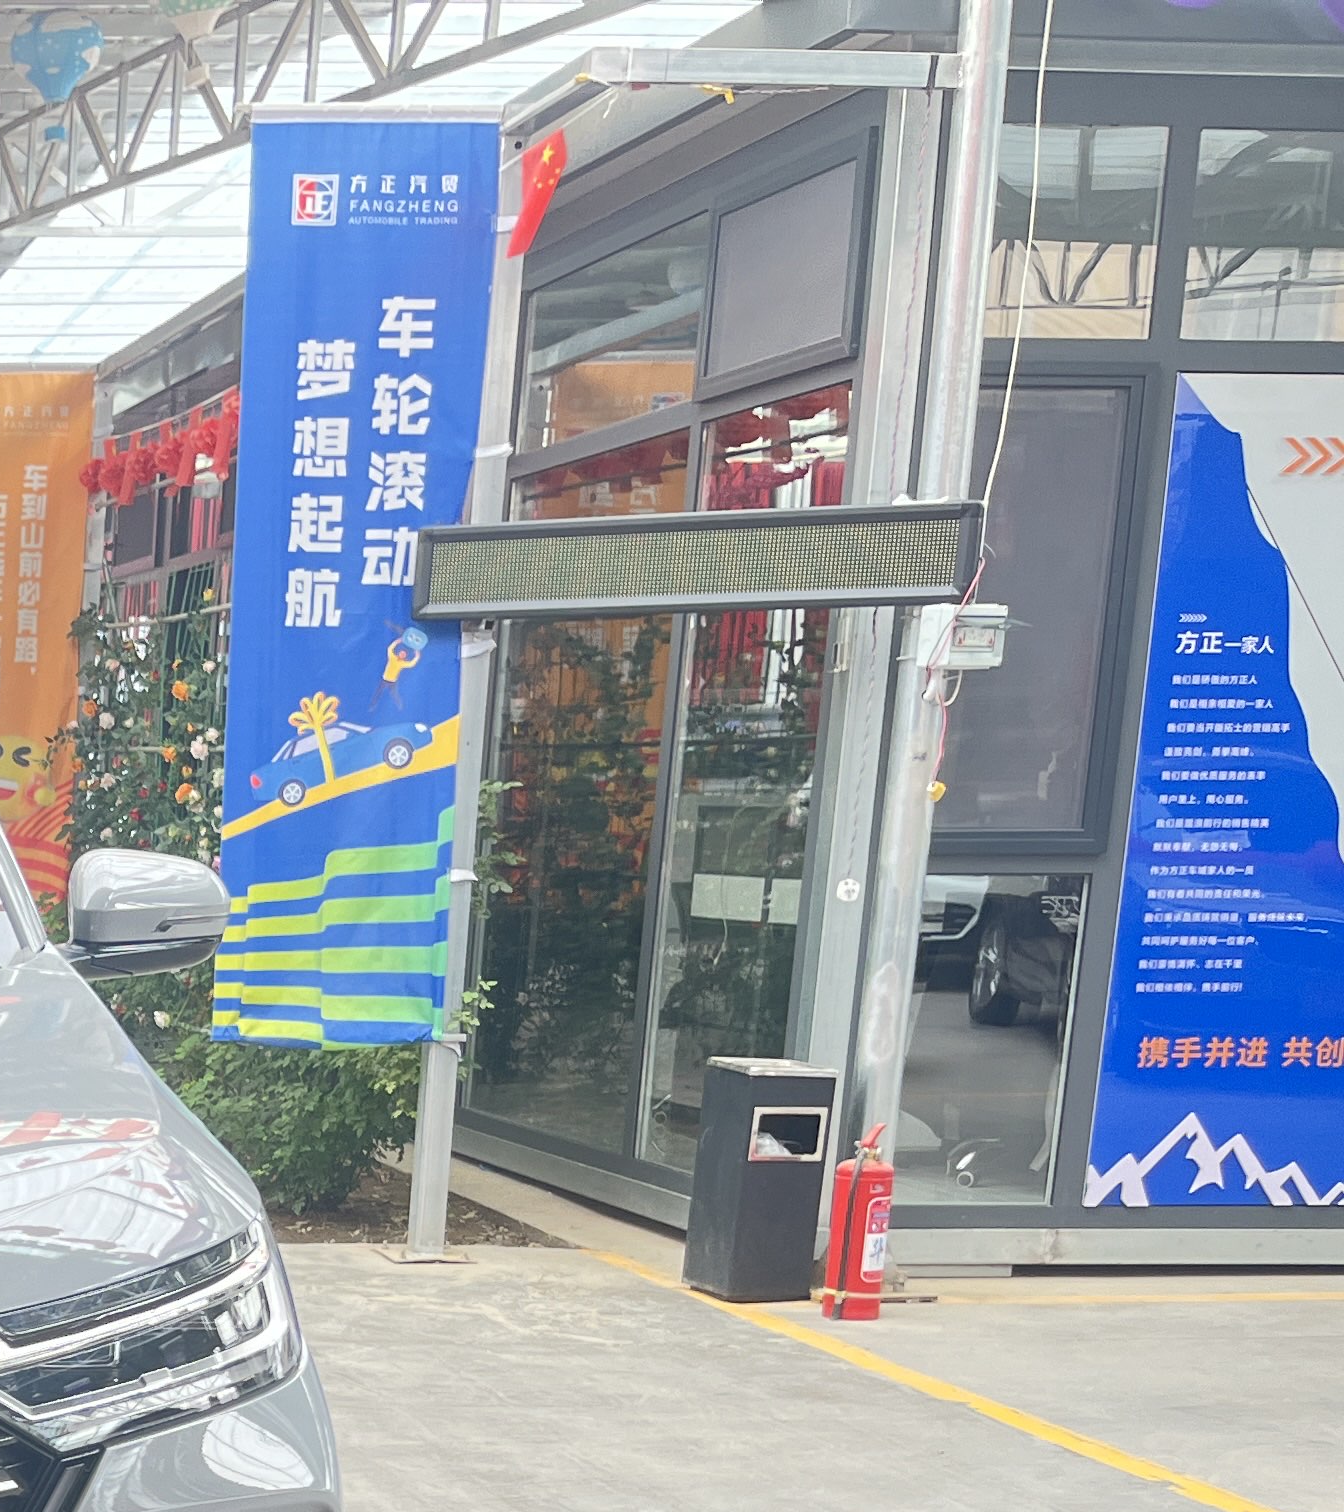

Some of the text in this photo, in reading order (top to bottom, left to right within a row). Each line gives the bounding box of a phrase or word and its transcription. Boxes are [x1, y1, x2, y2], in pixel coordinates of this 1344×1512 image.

[349, 174, 459, 194] 方正汽贸
[349, 199, 459, 213] FANGZHENG
[348, 216, 458, 225] AUTOMOBILE TRADING
[361, 296, 436, 586] 车轮滚动
[285, 339, 356, 628] 梦想起航
[1175, 631, 1275, 654] 方正一家人
[1169, 698, 1274, 709] 我们是相亲相爱的一家人
[1150, 865, 1254, 876] 作为方正车城家人的一员
[1137, 1036, 1344, 1069] 携手并进 共创
